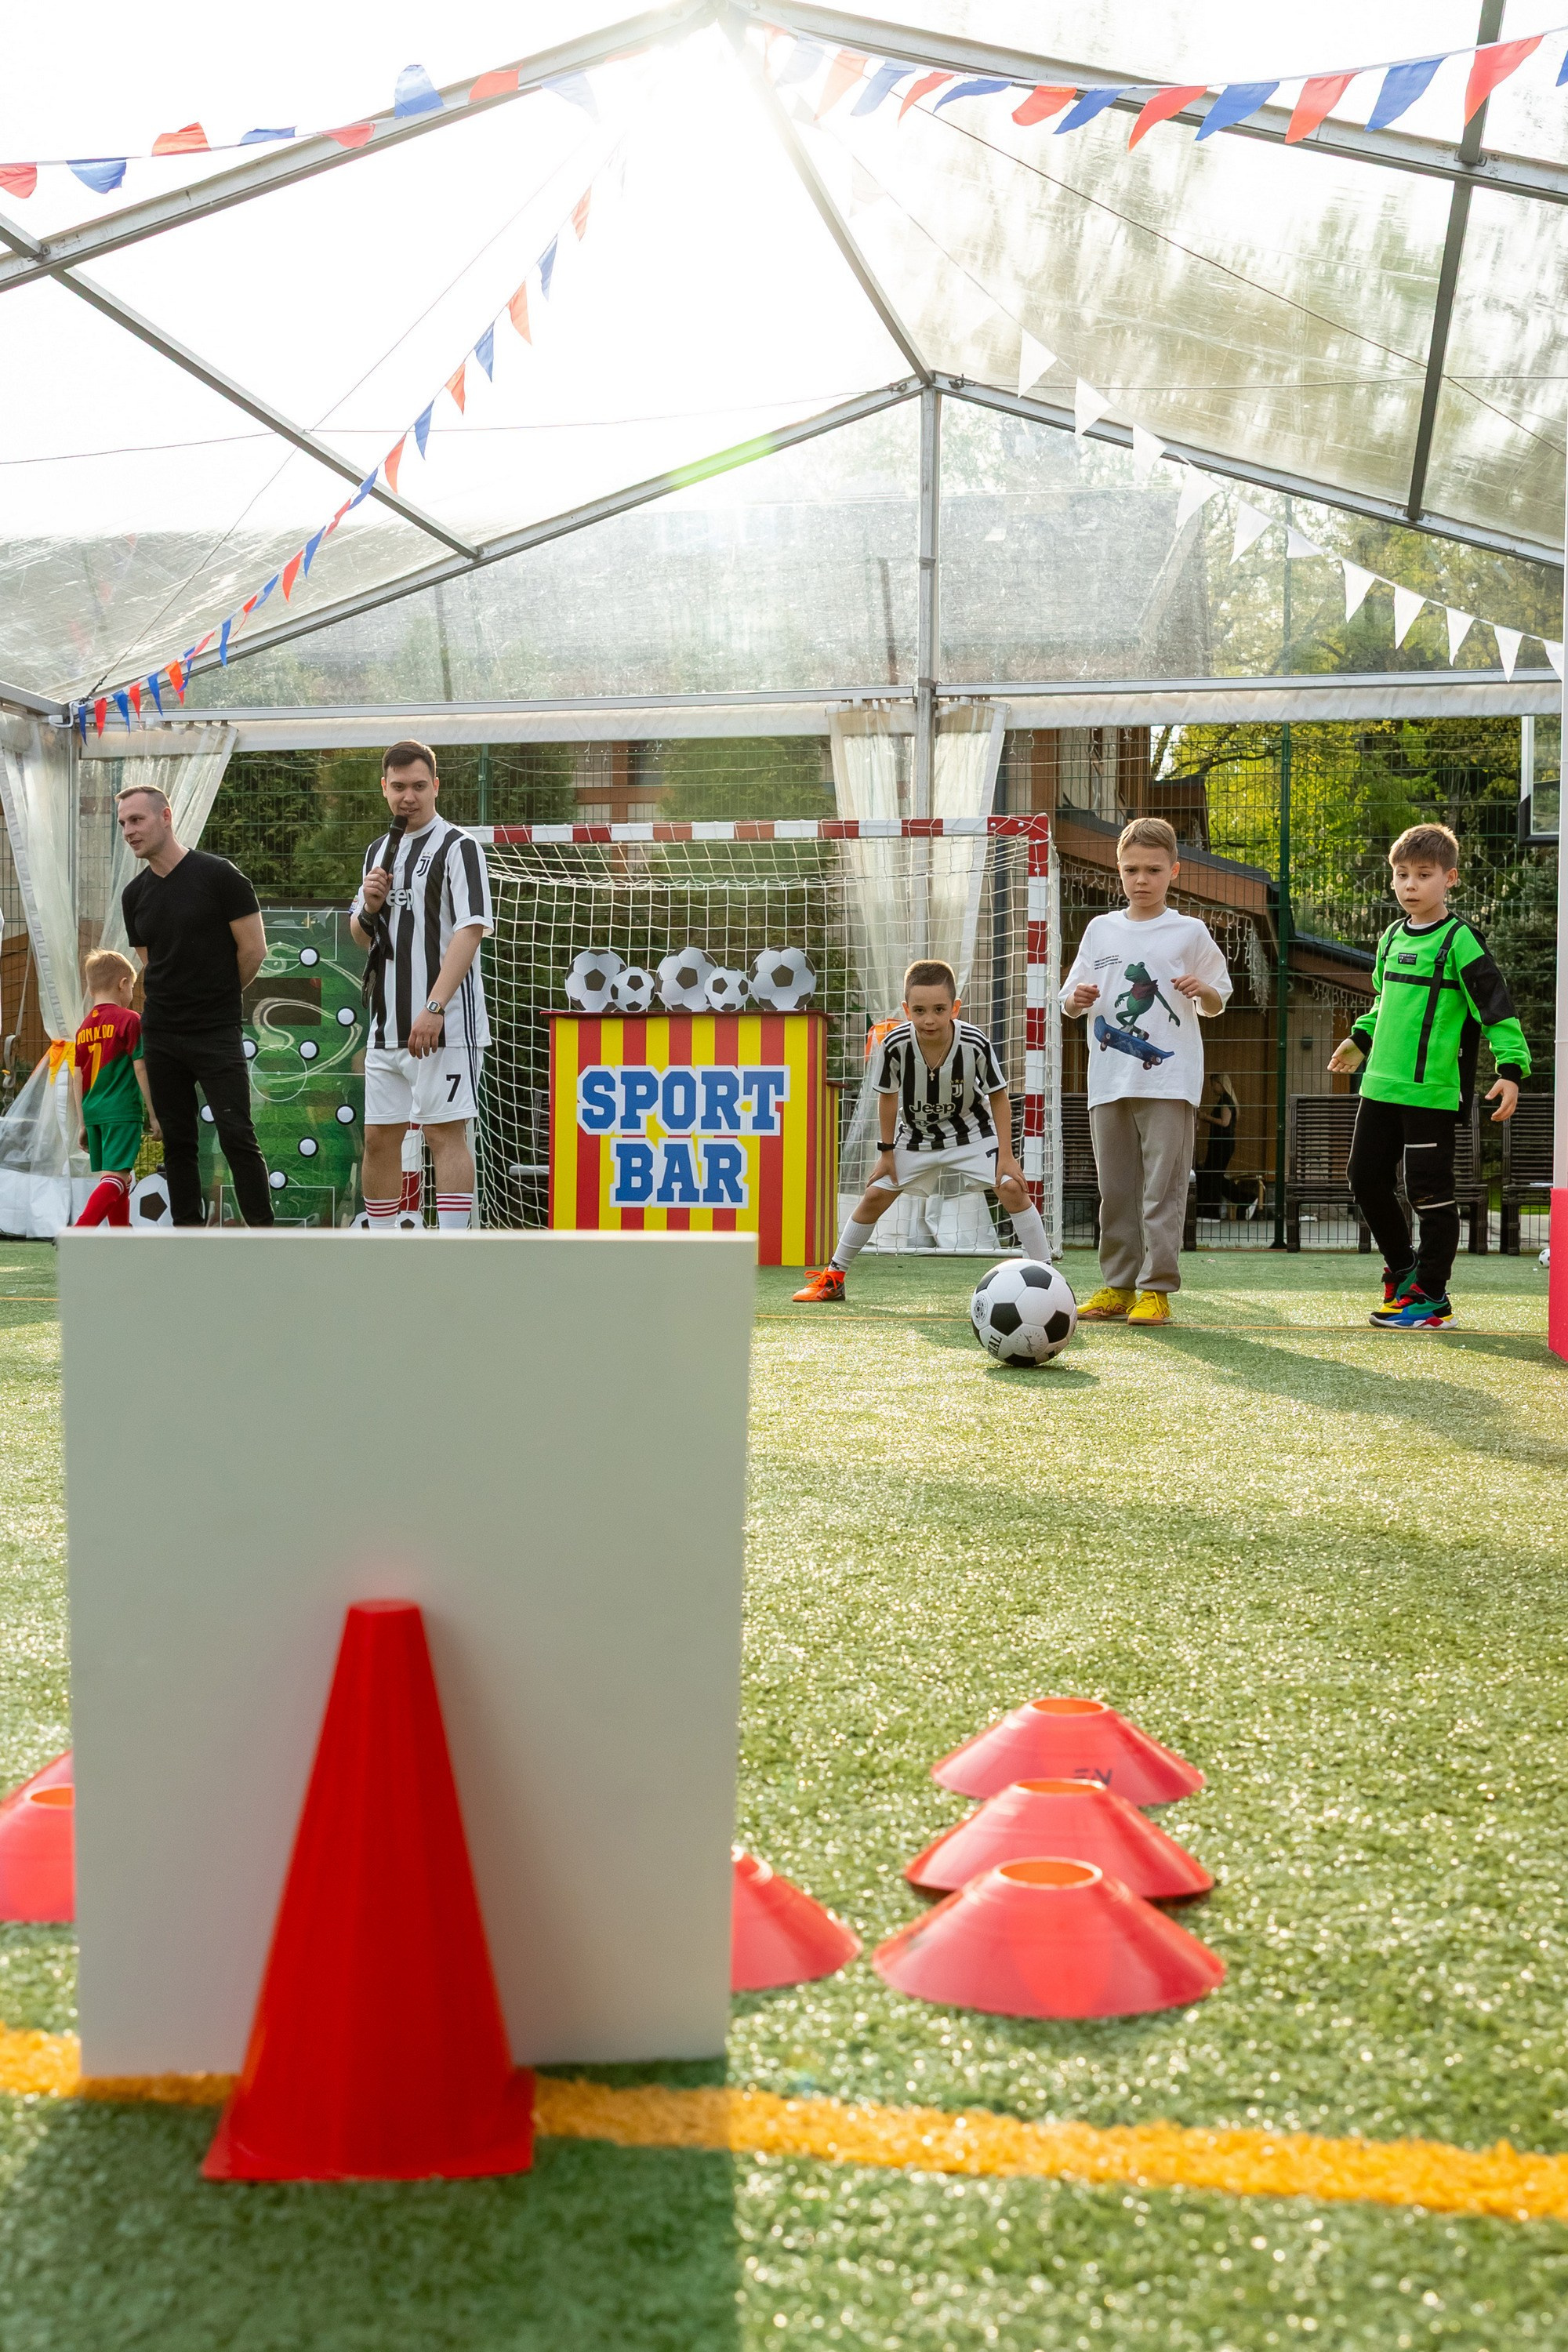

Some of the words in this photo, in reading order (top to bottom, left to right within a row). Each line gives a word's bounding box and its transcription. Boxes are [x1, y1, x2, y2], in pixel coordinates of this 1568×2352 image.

[385, 887, 415, 911] eep
[88, 1042, 103, 1090] 7
[446, 1073, 462, 1103] 7
[580, 1069, 786, 1132] SPORT
[909, 1100, 956, 1115] Jeep
[613, 1142, 746, 1205] BAR
